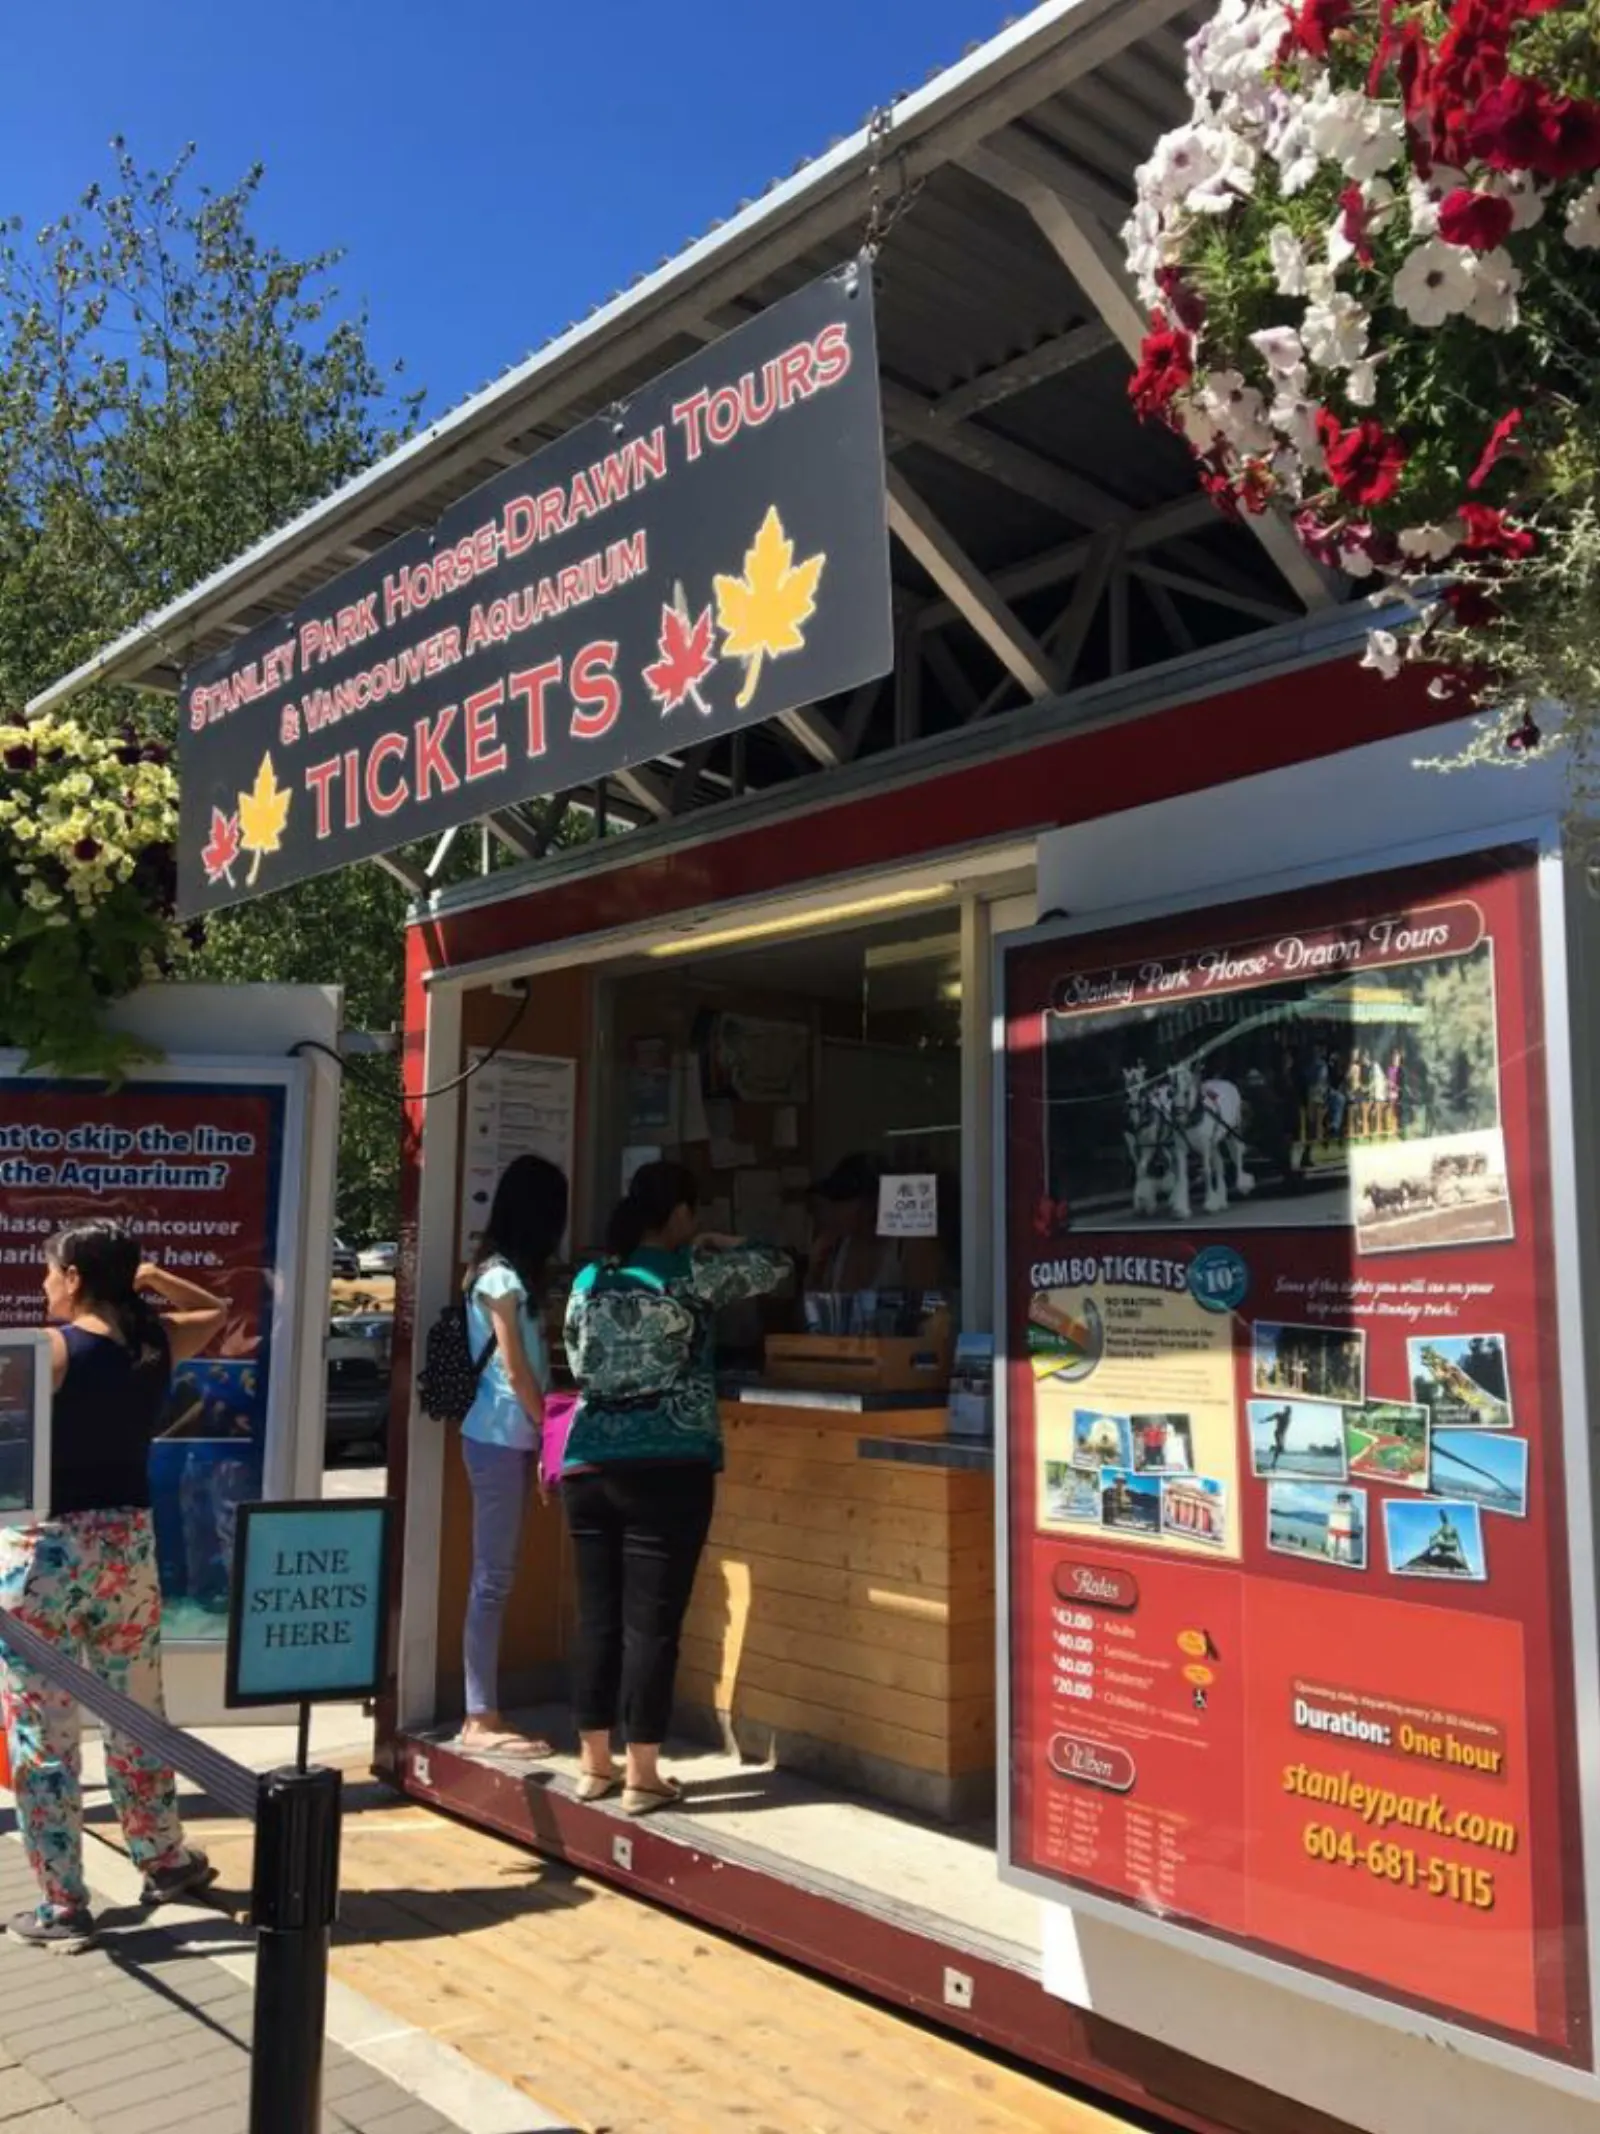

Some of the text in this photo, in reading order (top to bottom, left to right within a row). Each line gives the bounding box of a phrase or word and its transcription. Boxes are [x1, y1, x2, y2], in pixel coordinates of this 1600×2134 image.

[189, 321, 852, 731] STANLEY PARK HORSE-DRAWN TOURS
[279, 529, 648, 746] & VANCOUVER AQUARIUM
[305, 640, 621, 840] TICKETS
[1064, 970, 1135, 1007] Stanley
[1139, 957, 1192, 994] Park
[1368, 919, 1450, 954] Tours
[28, 1124, 63, 1151] to
[66, 1122, 133, 1158] skip
[138, 1124, 197, 1154] the
[196, 1127, 256, 1156] line
[0, 1158, 229, 1194] the Aquarium?
[163, 1245, 225, 1265] here.
[1030, 1255, 1187, 1290] COMBO TICKETS
[1399, 1278, 1426, 1293] will
[275, 1548, 350, 1577] LINE
[251, 1583, 368, 1614] STARTS
[265, 1620, 352, 1648] HERE
[1293, 1697, 1503, 1774] Duration: One hour
[1282, 1762, 1517, 1853] stanleypark.com
[1302, 1822, 1495, 1909] 604-681-5115
